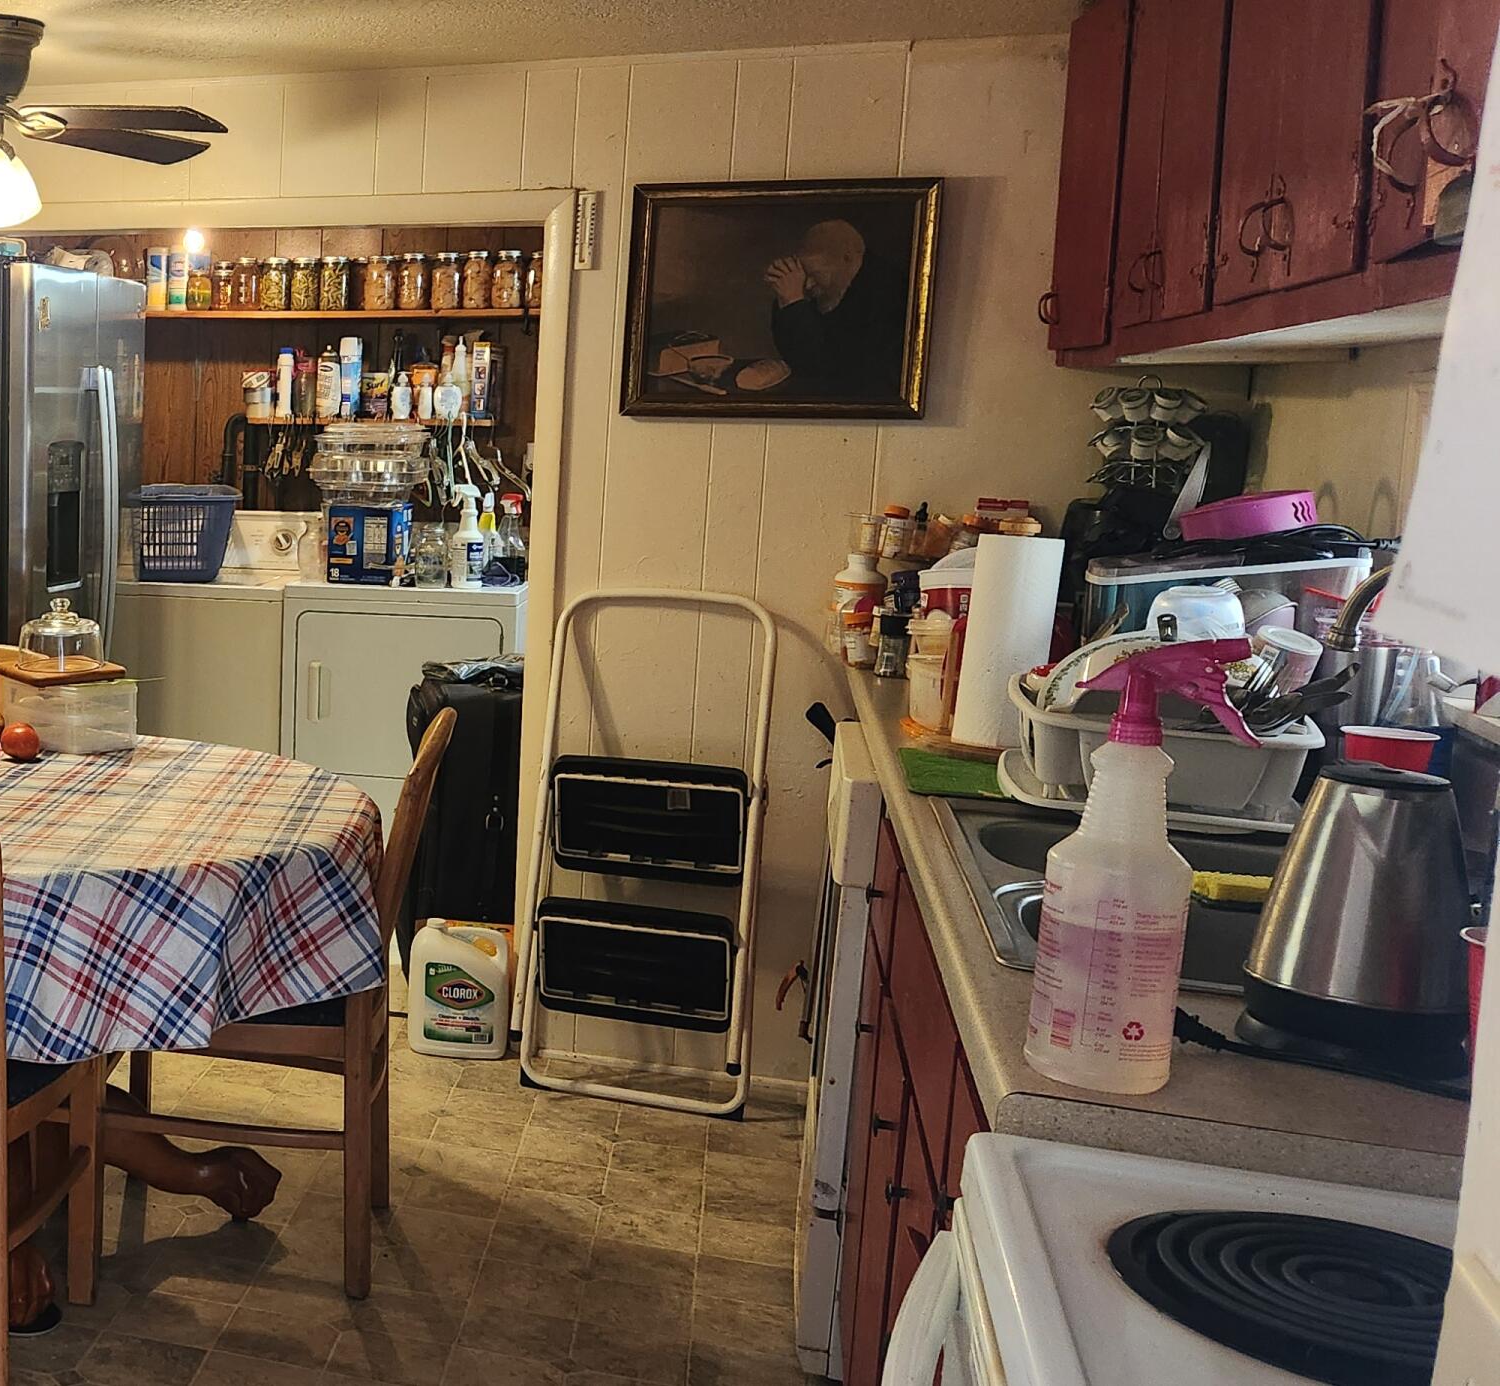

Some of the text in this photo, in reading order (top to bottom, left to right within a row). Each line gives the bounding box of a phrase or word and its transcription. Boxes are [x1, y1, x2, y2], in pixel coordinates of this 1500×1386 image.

[366, 379, 385, 391] Surf
[329, 568, 340, 578] 18
[442, 986, 478, 1000] CLOROX
